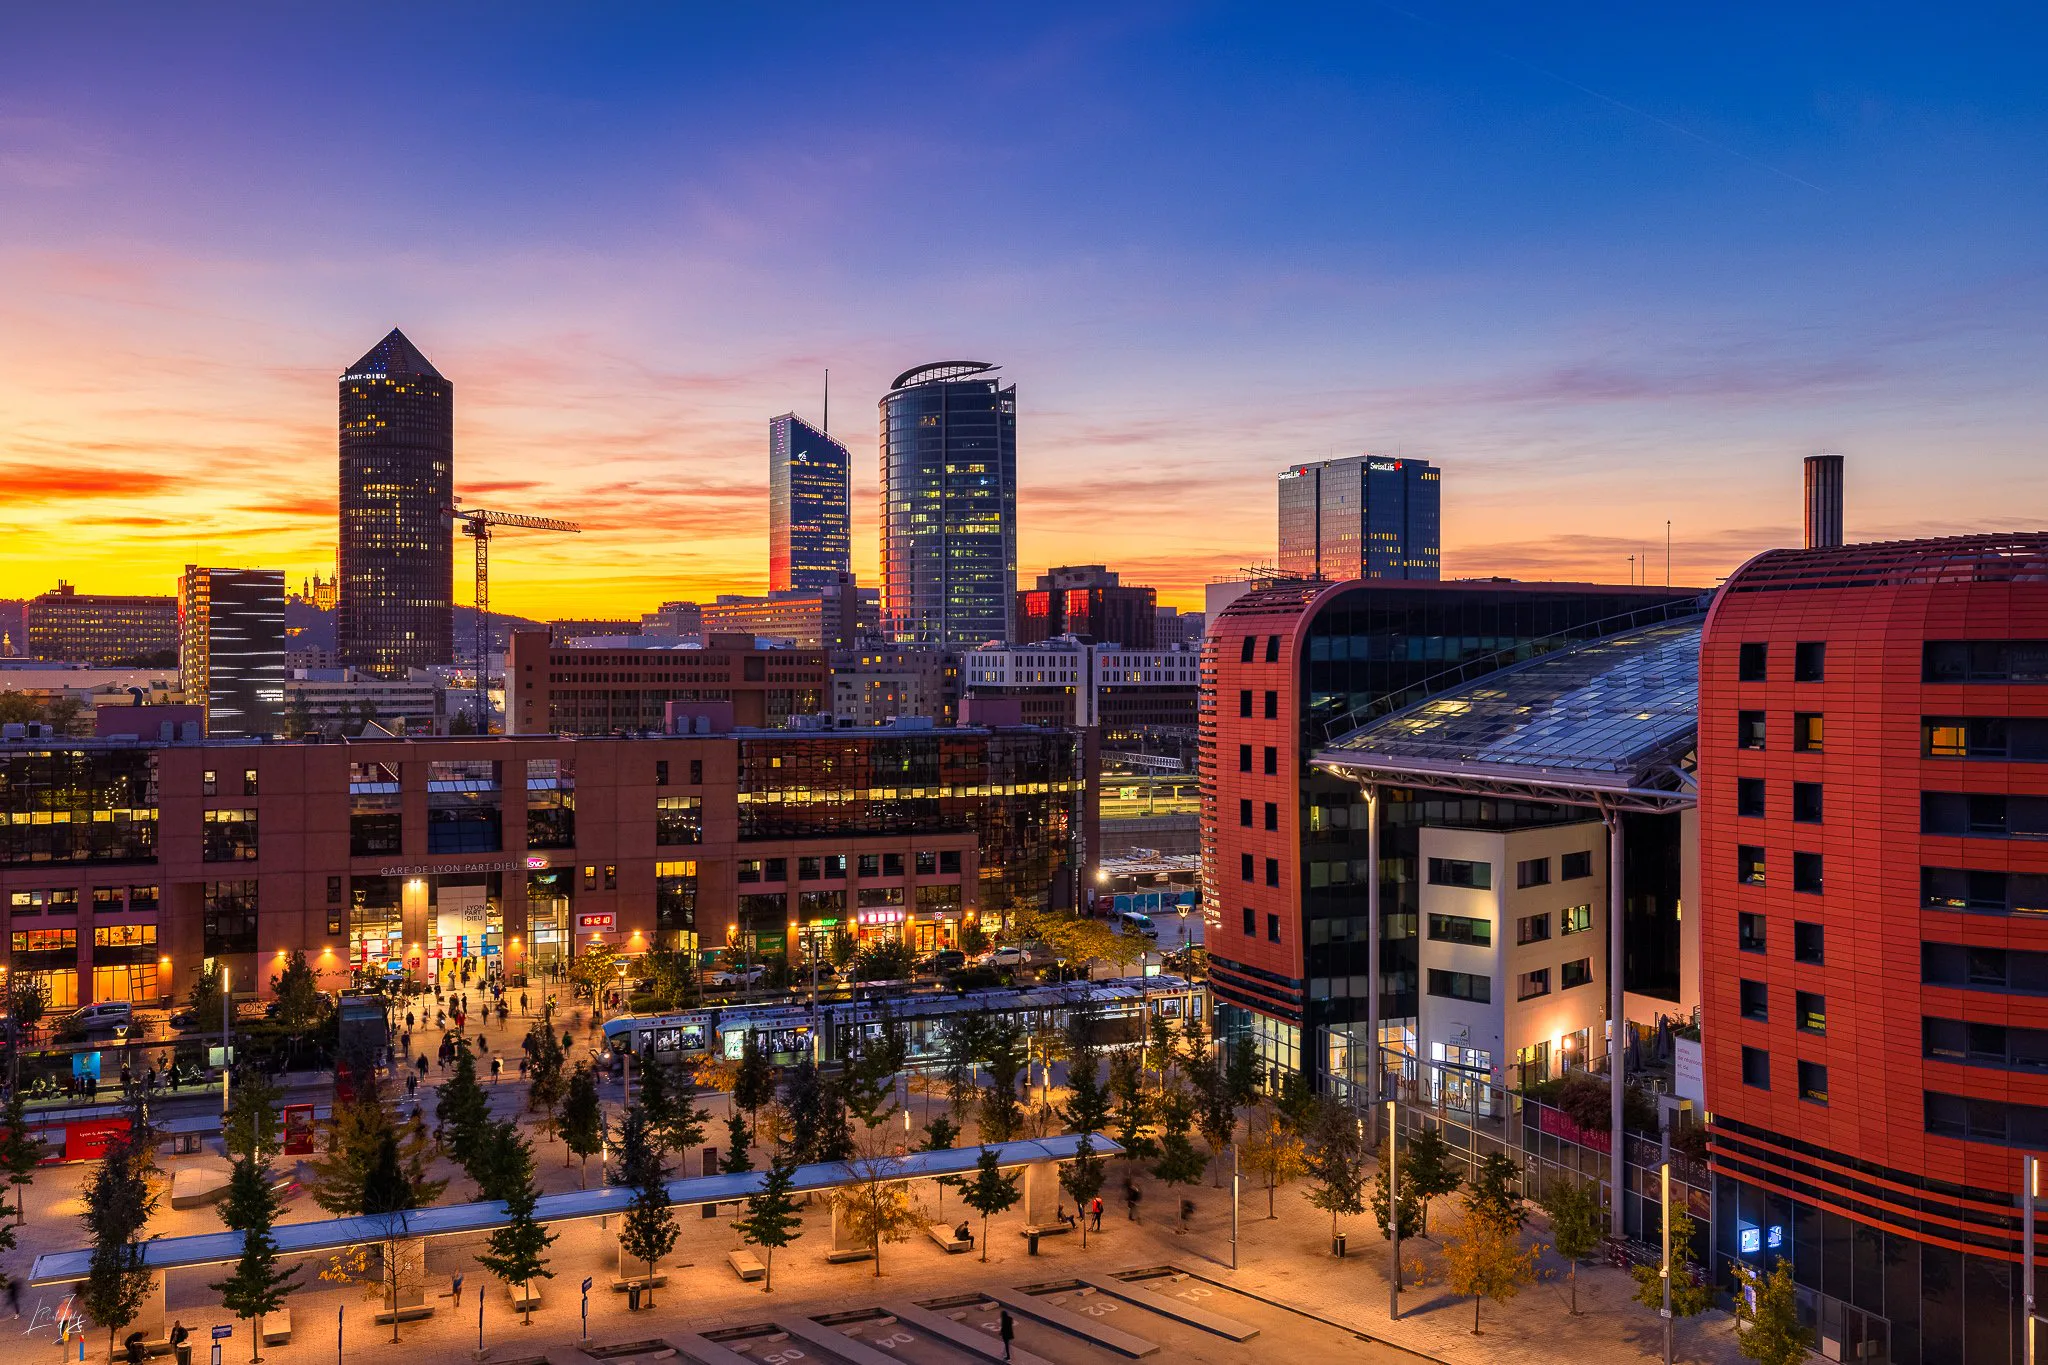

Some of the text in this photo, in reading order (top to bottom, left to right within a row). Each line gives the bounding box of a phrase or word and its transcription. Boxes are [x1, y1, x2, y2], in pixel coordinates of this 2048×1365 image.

[1370, 461, 1394, 471] SwissLife
[381, 862, 518, 875] GARE DE LYON PART-DIEU
[1176, 1288, 1213, 1302] 01
[1079, 1302, 1119, 1316] 02
[875, 1332, 914, 1349] 04
[764, 1349, 805, 1365] 05
